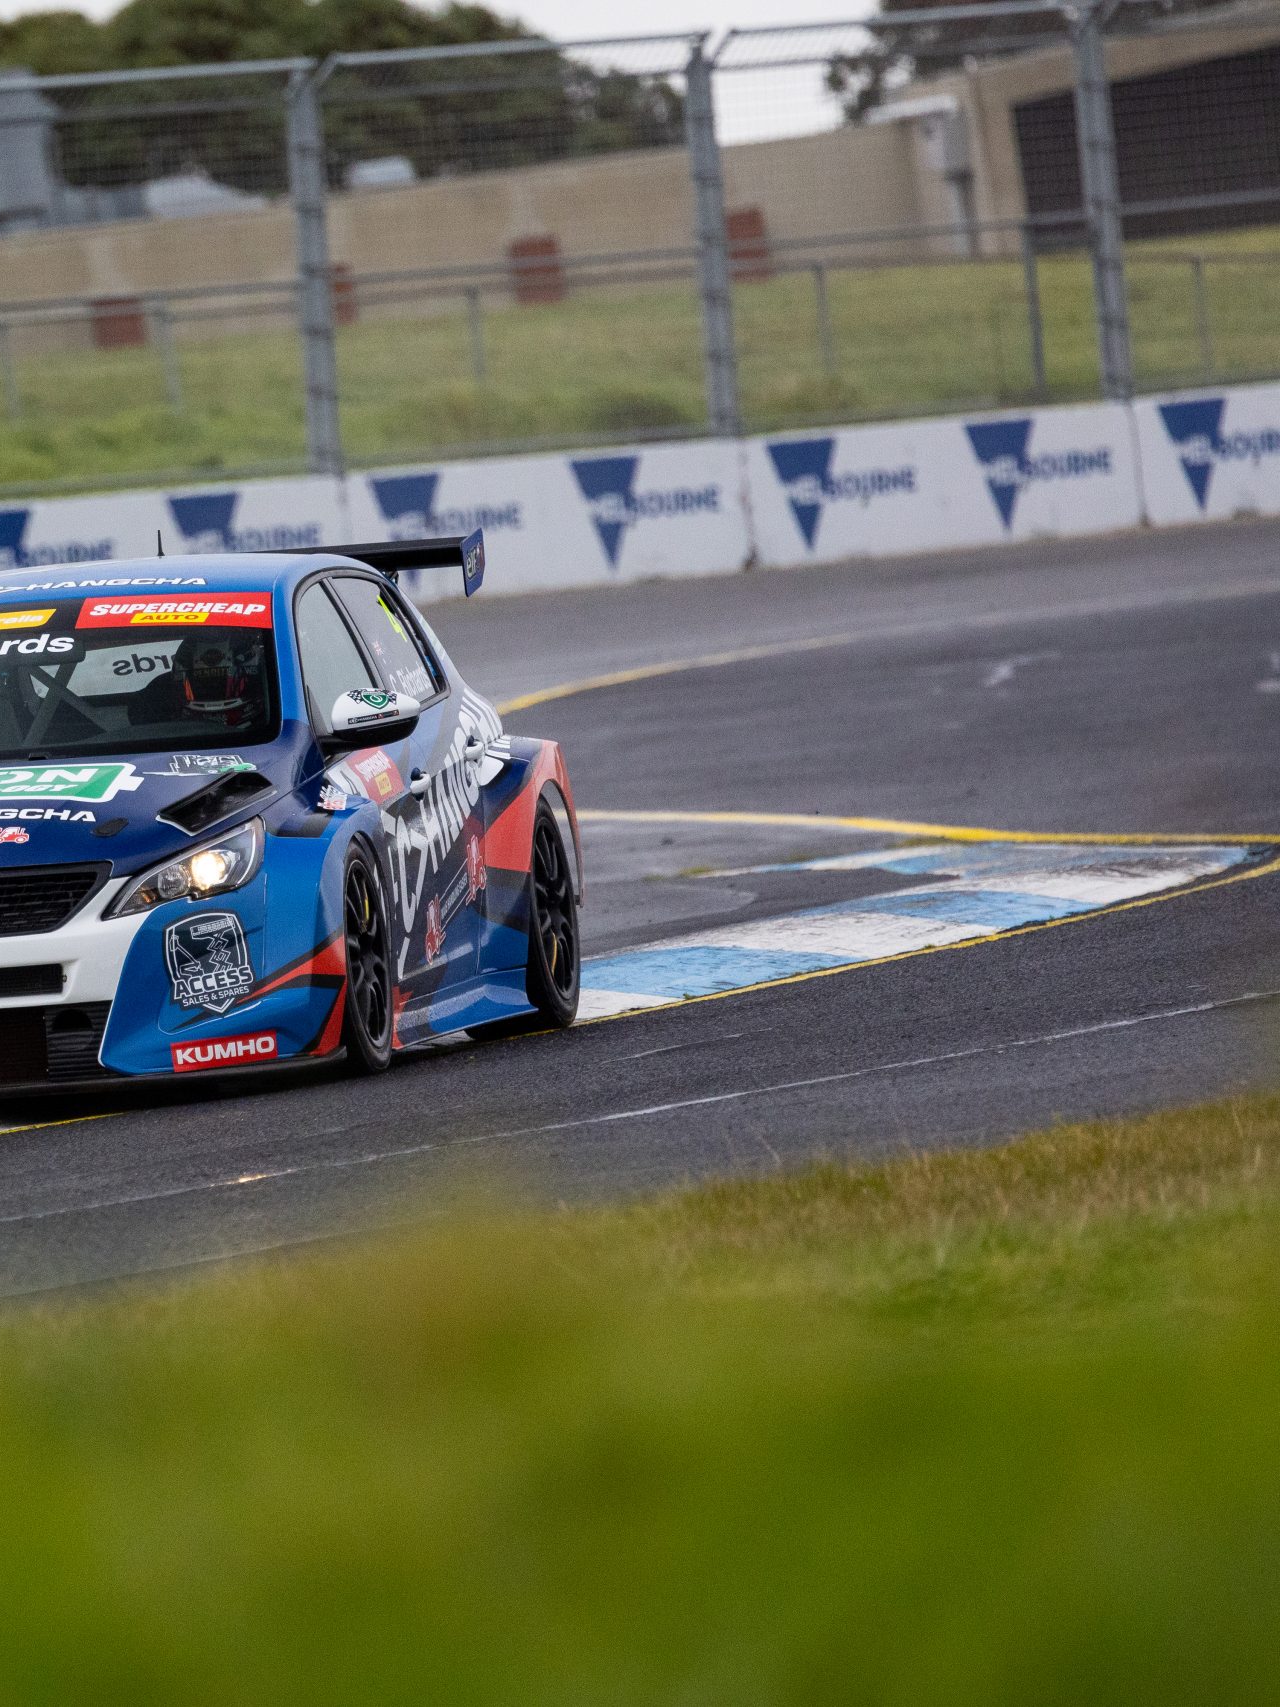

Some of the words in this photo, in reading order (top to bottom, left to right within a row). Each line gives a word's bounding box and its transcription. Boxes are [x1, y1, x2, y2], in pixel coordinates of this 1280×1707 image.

[26, 577, 207, 591] HANGCHA
[90, 602, 266, 616] SUPERCHEAP
[174, 965, 254, 1000] ACCESS
[182, 995, 210, 1007] SALES
[211, 993, 218, 1001] &
[218, 986, 250, 999] SPARES
[176, 1036, 275, 1065] KUMHO
